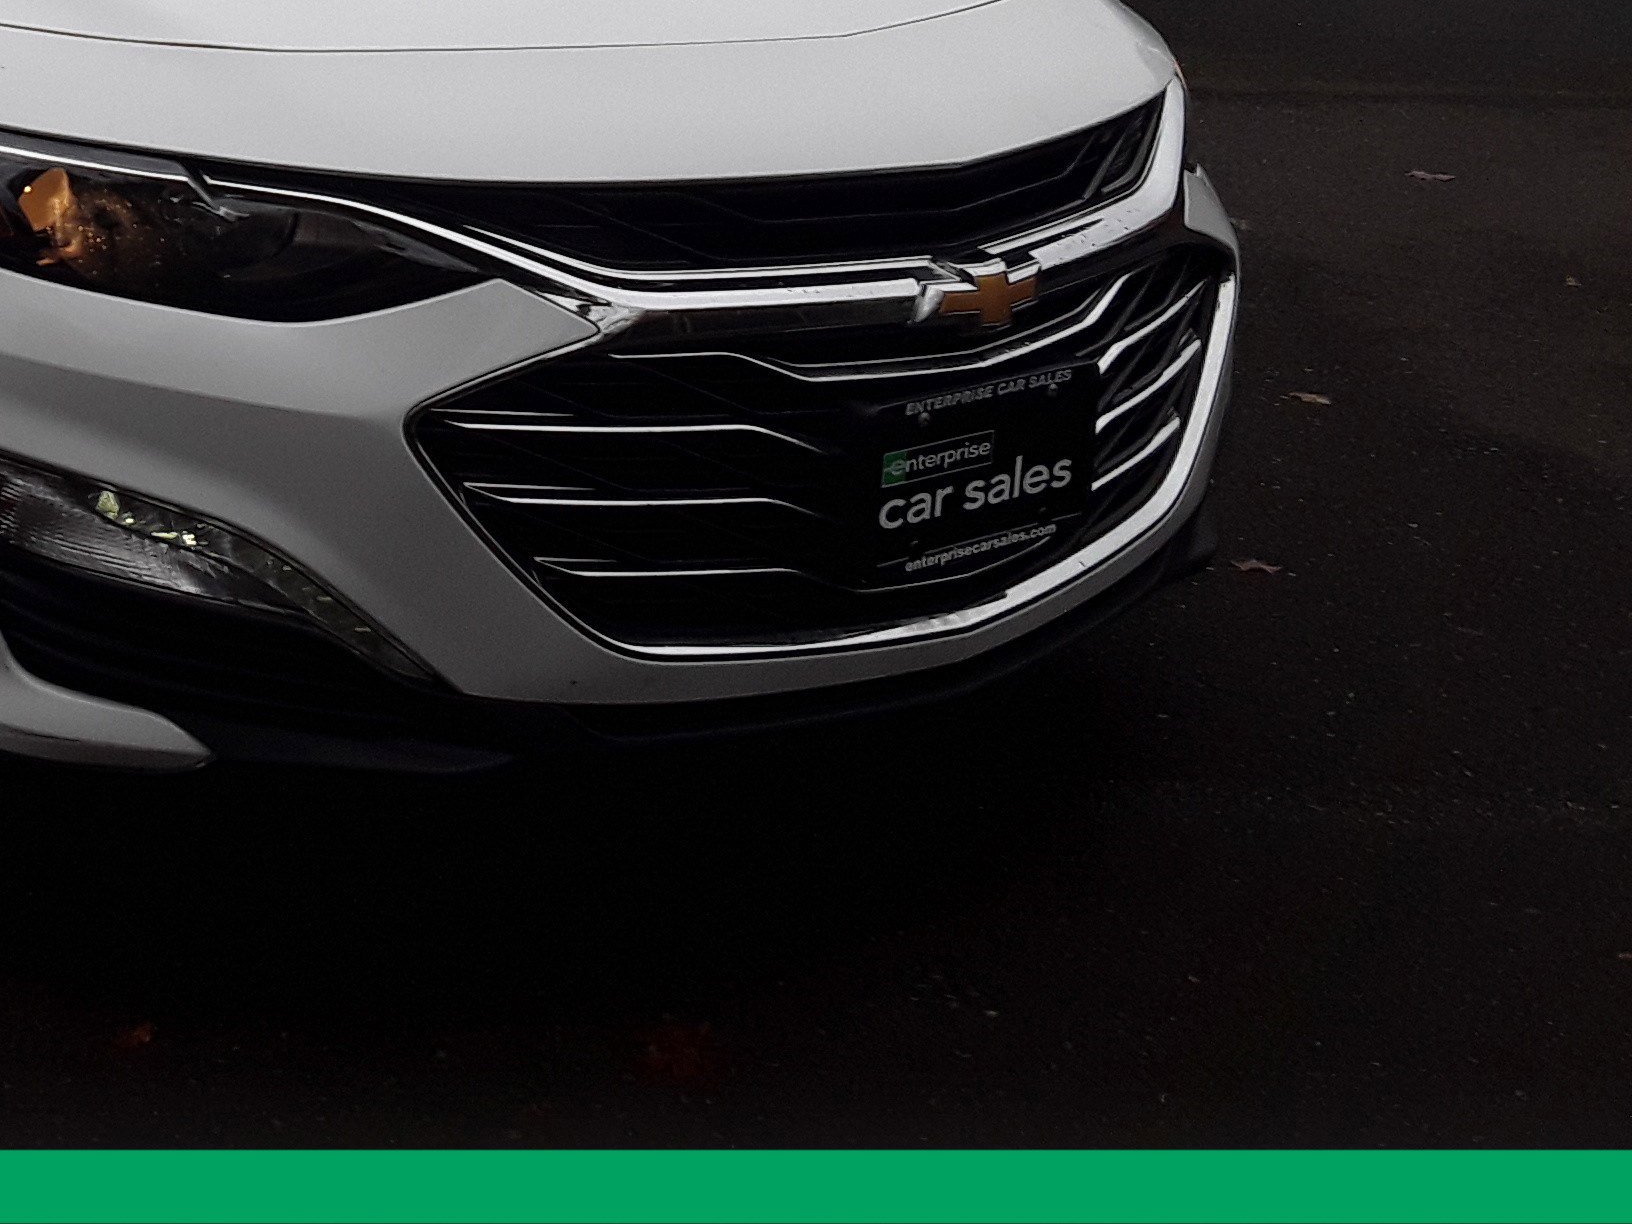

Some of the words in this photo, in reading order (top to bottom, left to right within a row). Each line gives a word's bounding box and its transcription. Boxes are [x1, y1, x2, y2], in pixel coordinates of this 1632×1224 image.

[905, 385, 995, 416] ENTERPRISE
[997, 378, 1026, 395] CAR
[1028, 369, 1072, 388] SALES
[885, 441, 991, 474] enterprise
[878, 485, 955, 529] car
[962, 454, 1073, 510] sales
[904, 523, 1058, 572] enterprisecarsales.com
